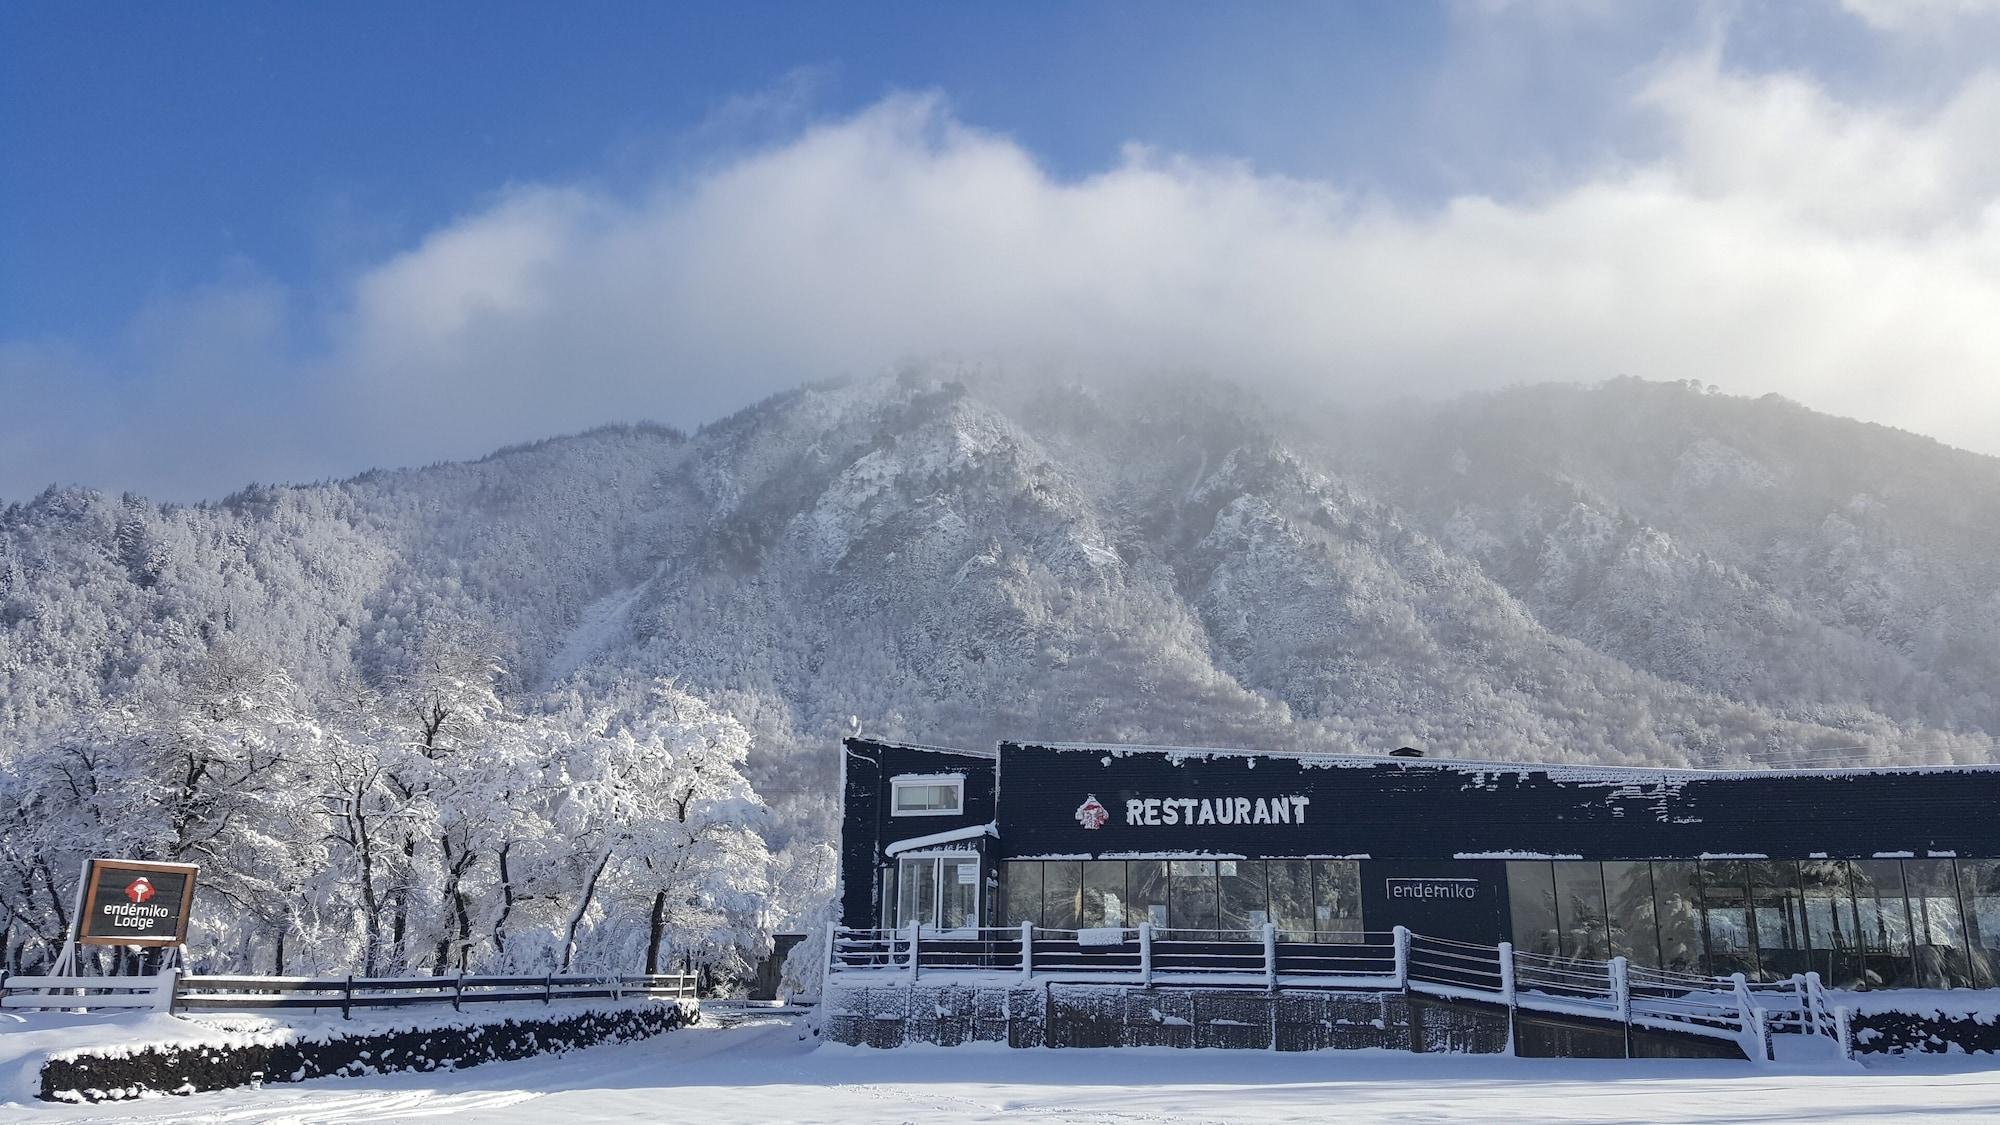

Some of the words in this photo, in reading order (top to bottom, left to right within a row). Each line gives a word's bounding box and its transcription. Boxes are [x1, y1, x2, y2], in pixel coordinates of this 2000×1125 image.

[1126, 797, 1310, 826] RESTAURANT
[1393, 883, 1475, 898] endémiko
[103, 903, 169, 918] endémiko
[114, 915, 154, 930] Lodge
